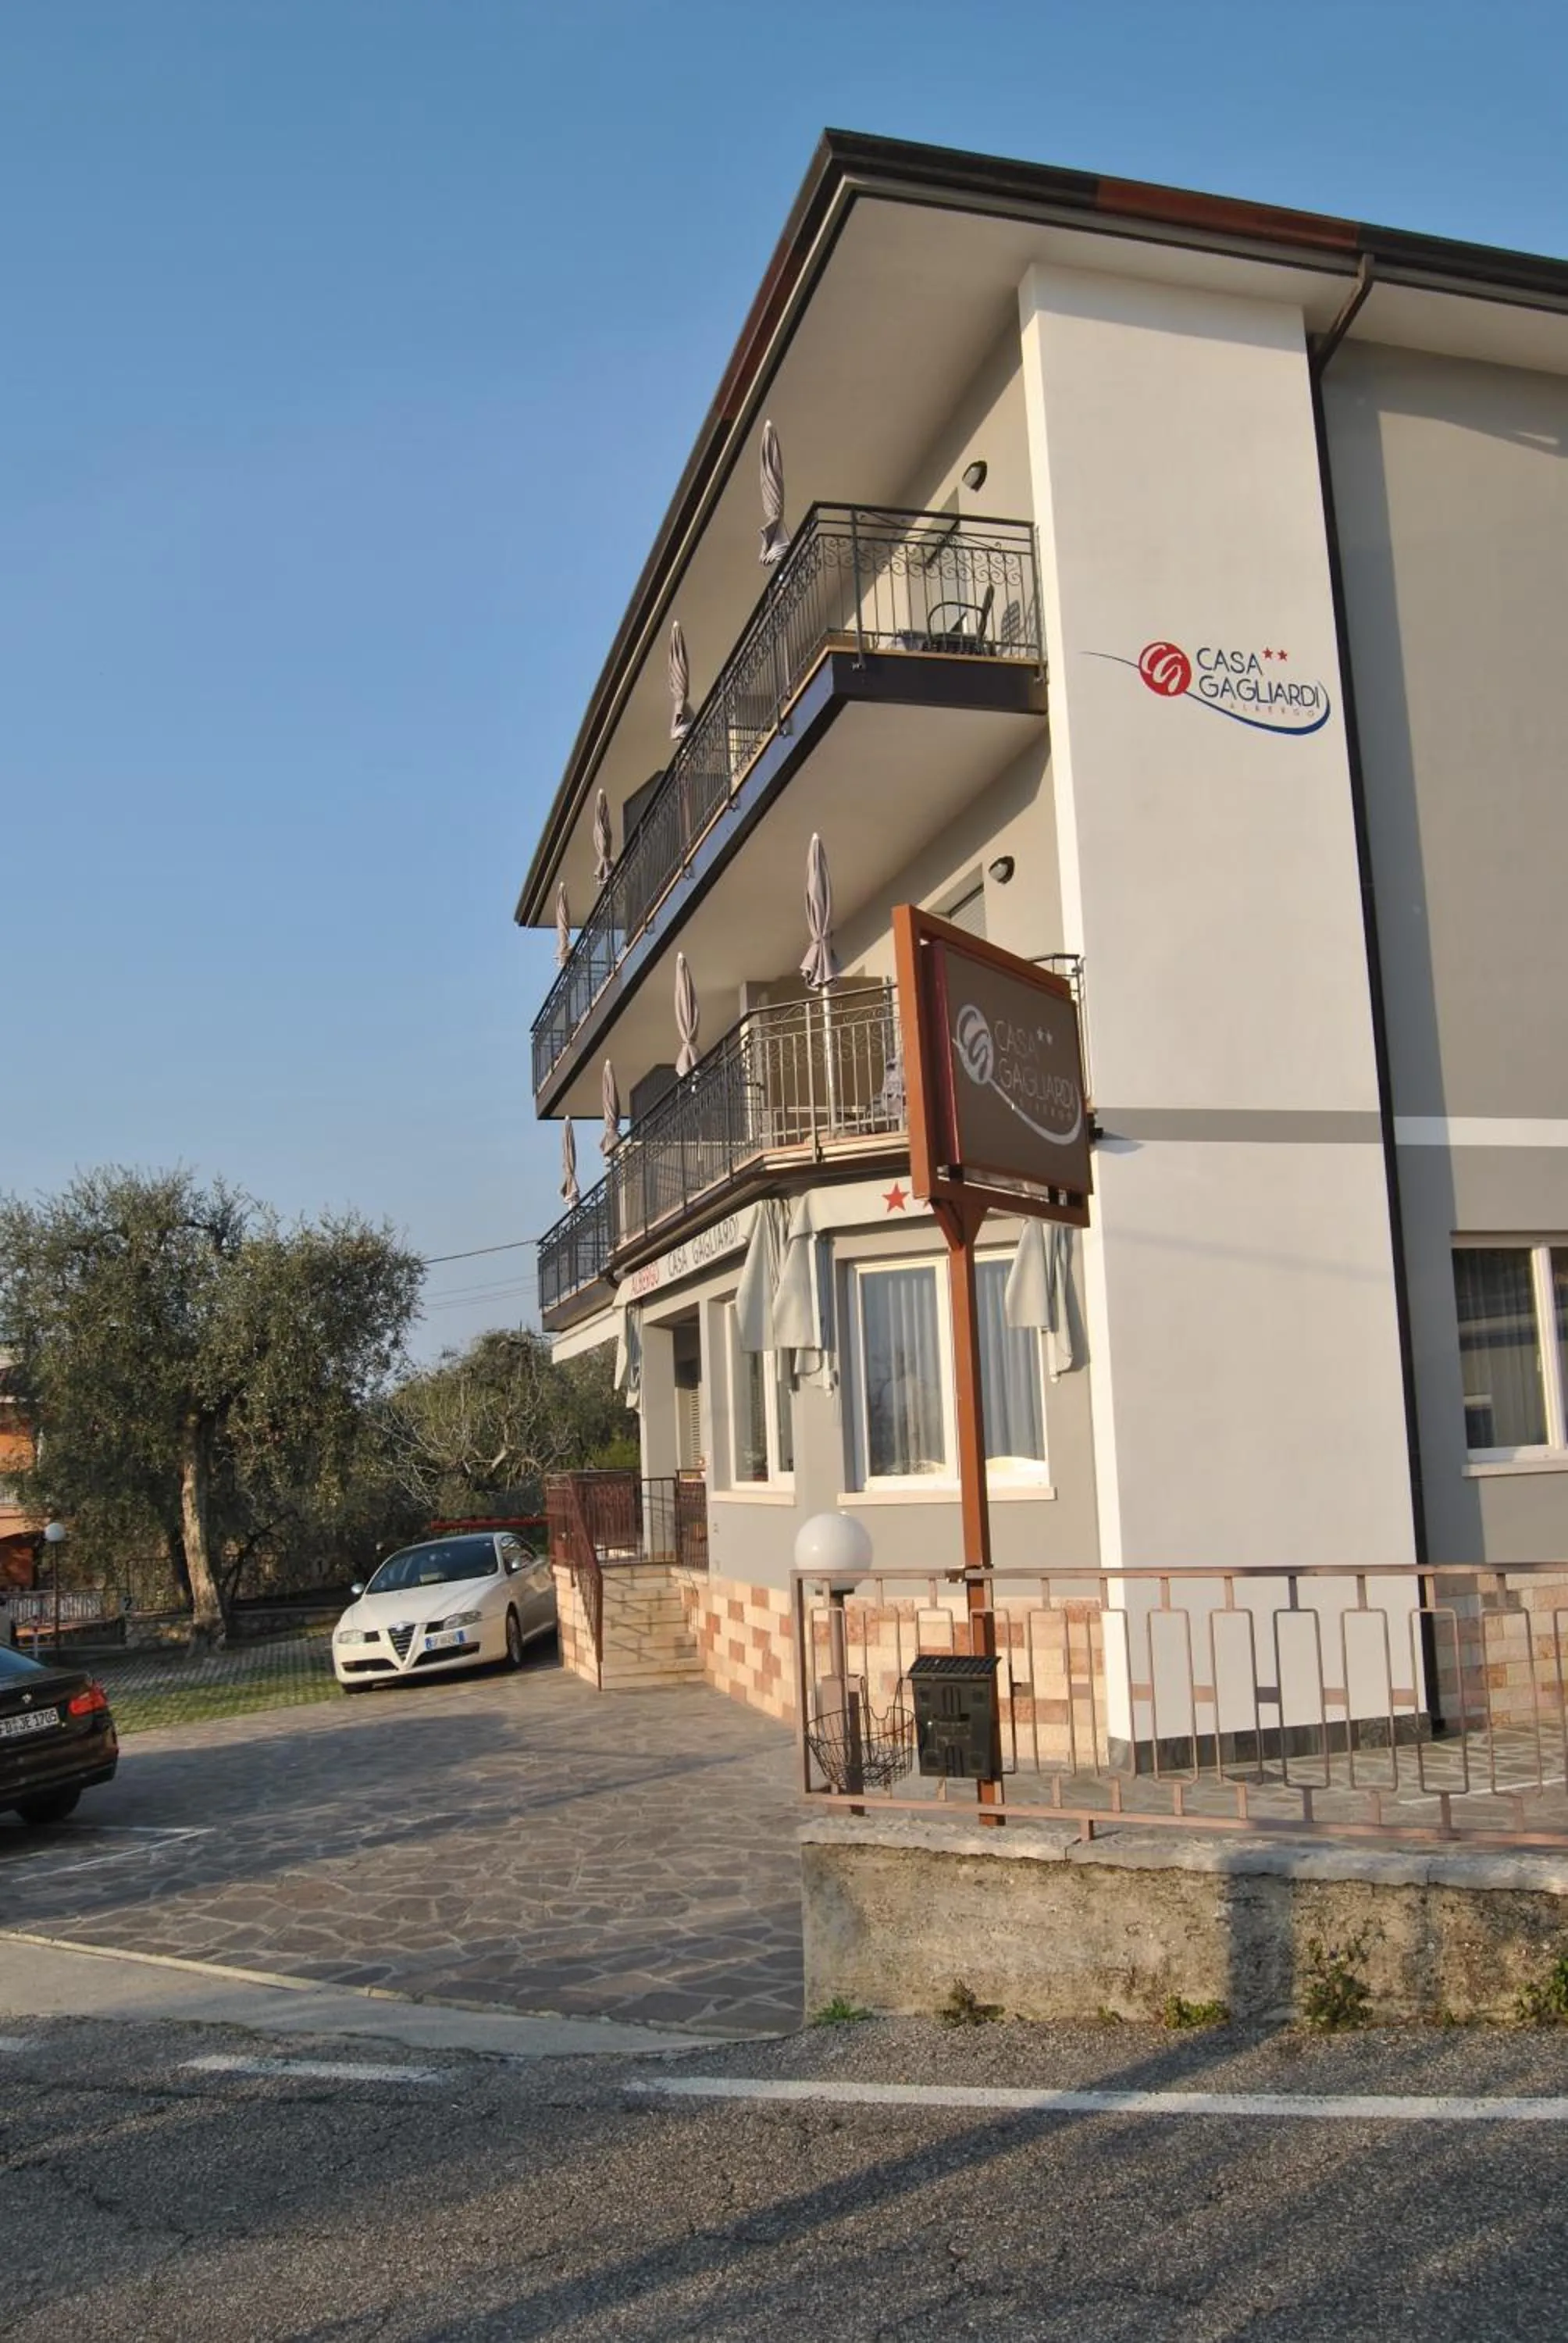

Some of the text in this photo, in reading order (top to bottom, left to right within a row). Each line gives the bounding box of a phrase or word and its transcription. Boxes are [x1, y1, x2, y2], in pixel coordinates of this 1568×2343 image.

[1196, 647, 1263, 676] CASA
[1199, 675, 1320, 708] GAGLIARDI
[994, 1019, 1039, 1063] CASA
[998, 1057, 1076, 1109] GAGLIARDI
[631, 1214, 739, 1295] ALBERGO CASA GAGLIARDI
